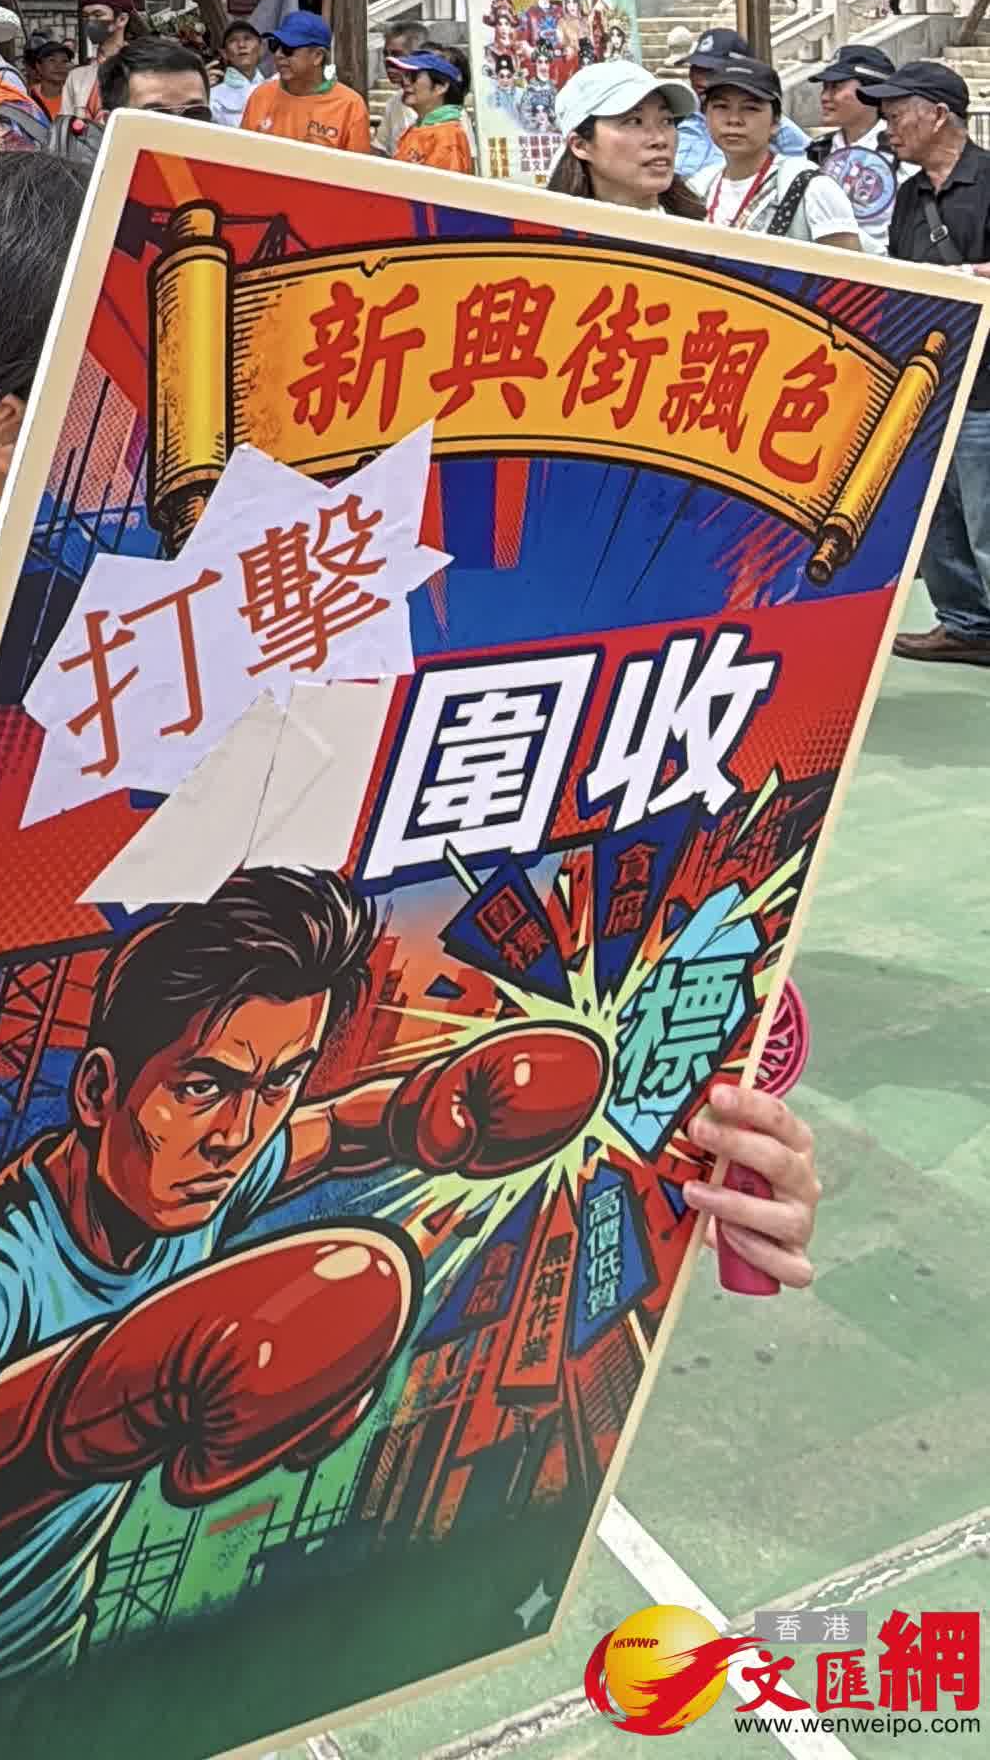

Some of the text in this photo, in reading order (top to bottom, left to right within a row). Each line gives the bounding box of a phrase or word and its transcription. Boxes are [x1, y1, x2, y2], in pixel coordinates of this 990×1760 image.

[287, 276, 839, 483] 新興街飄色
[57, 493, 393, 780] 打擊
[616, 955, 745, 1102] 標
